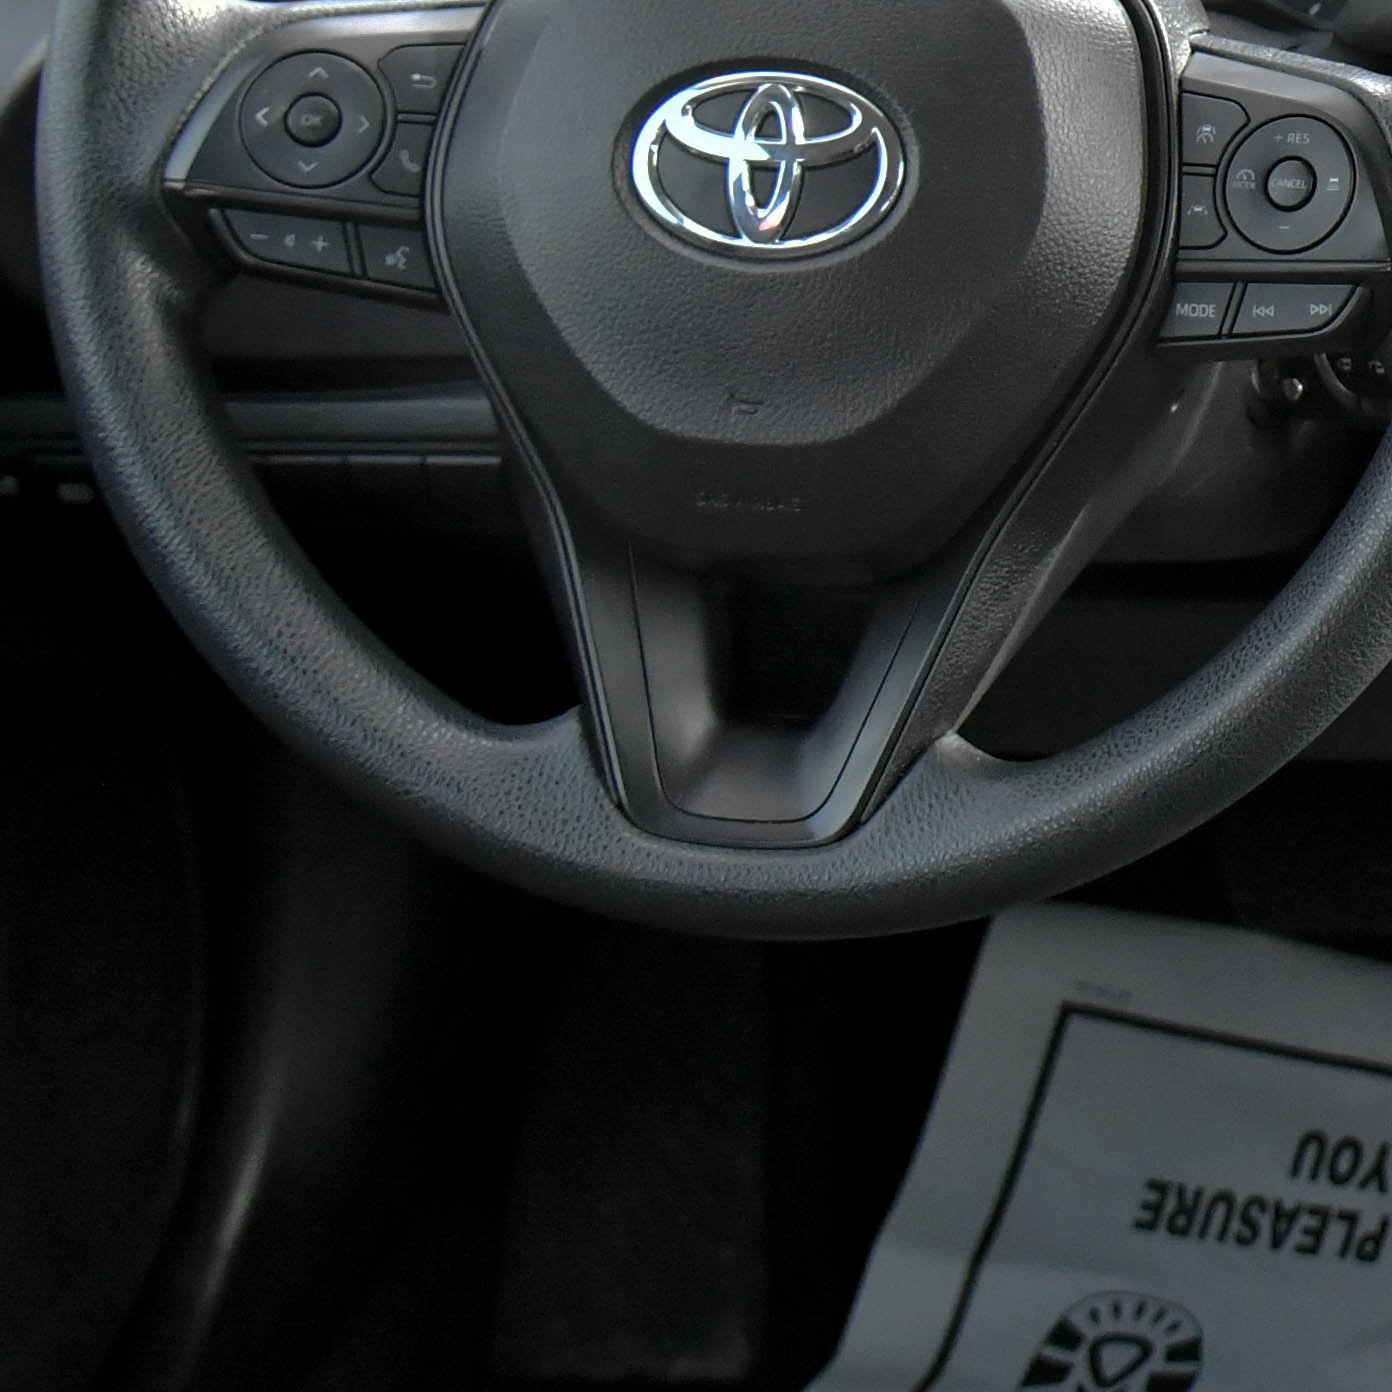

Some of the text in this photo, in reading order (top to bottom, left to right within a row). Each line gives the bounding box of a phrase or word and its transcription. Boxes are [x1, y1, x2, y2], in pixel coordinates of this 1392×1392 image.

[1287, 131, 1311, 145] RES
[1269, 178, 1306, 190] CANCEL
[1176, 302, 1217, 318] MODE
[1288, 1131, 1392, 1195] YOU
[1130, 1177, 1391, 1264] PLEASURE
